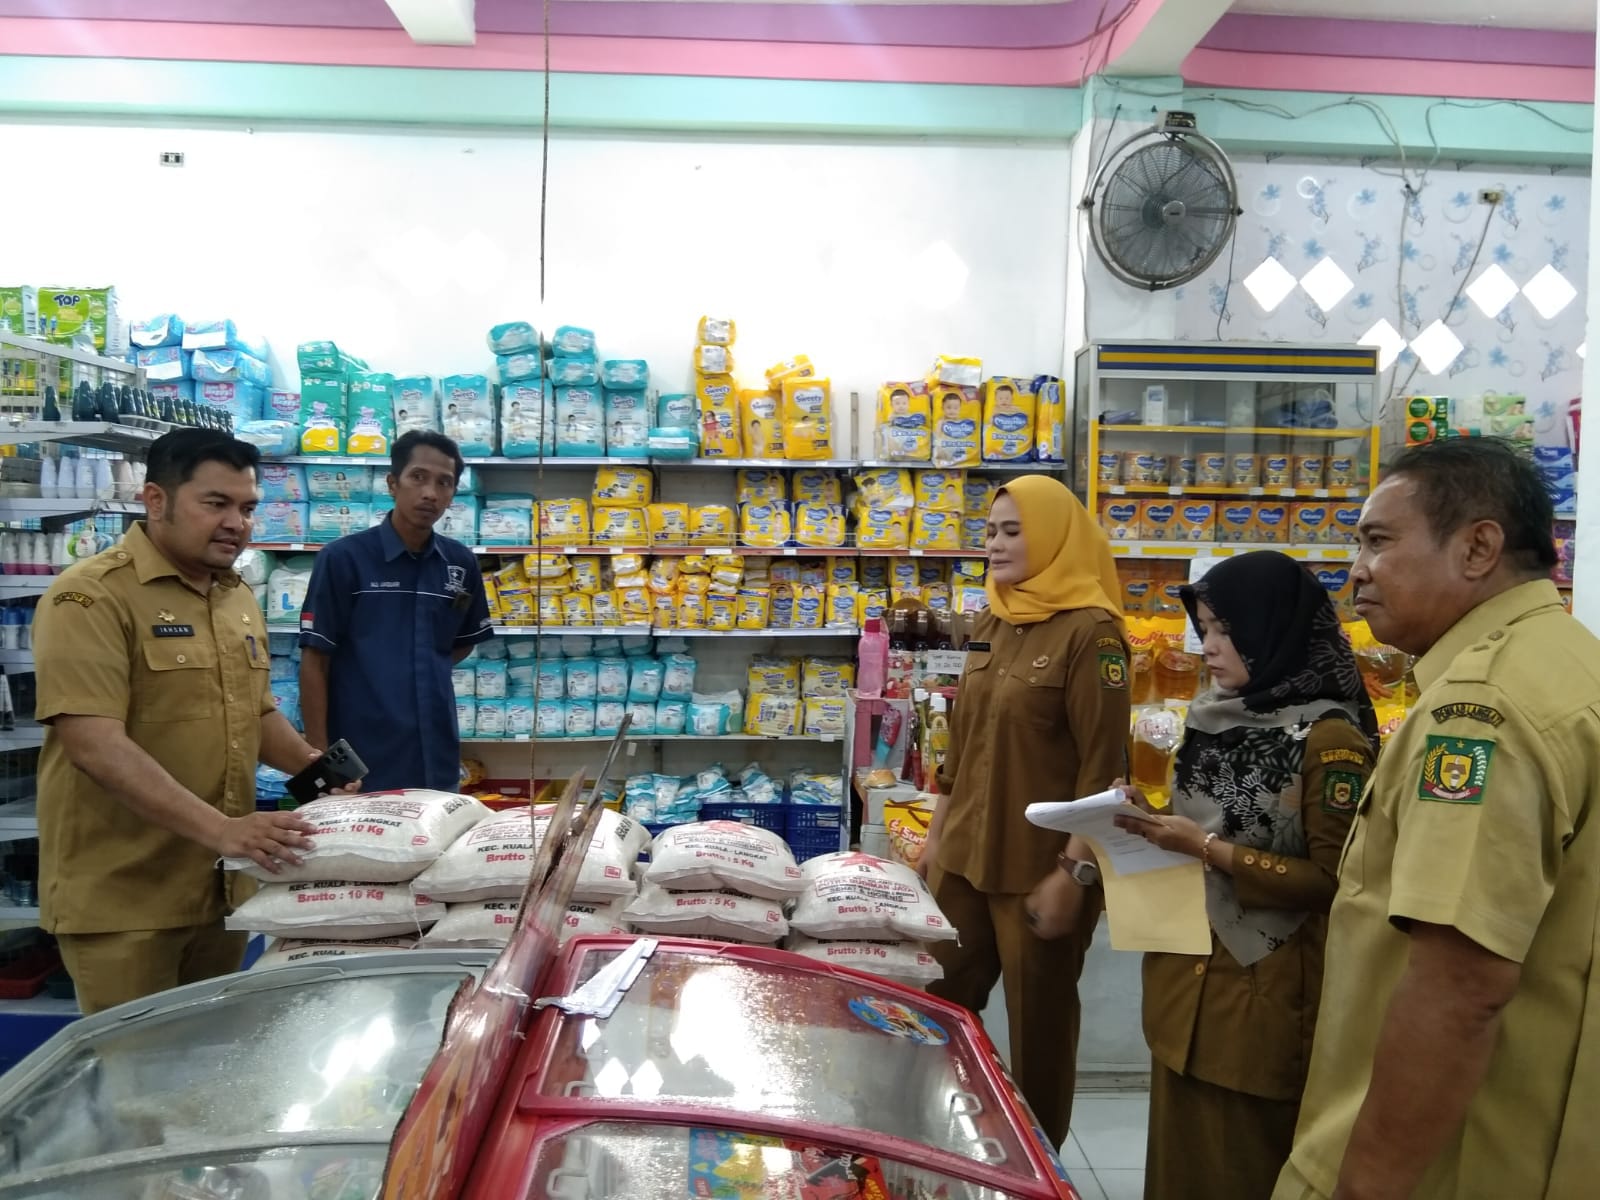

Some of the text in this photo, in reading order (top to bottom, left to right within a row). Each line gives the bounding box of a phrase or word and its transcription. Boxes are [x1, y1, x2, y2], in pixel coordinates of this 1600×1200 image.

[53, 294, 80, 306] TOP
[795, 393, 823, 403] Sweety
[282, 592, 295, 611] L
[358, 817, 402, 828] LANGKAT
[351, 824, 365, 832] 10
[368, 824, 385, 836] Kg
[477, 845, 499, 853] KEC.
[486, 853, 525, 863] Brutto
[695, 851, 725, 861] Brutto
[741, 858, 755, 868] Kg
[297, 893, 336, 903] Brutto
[348, 891, 362, 899] 10
[367, 889, 384, 900] Kg
[677, 898, 706, 906] Brutto
[714, 898, 721, 906] 5
[723, 899, 736, 908] Kg
[879, 902, 908, 911] ANGKAT
[288, 953, 310, 961] KEC.
[827, 947, 857, 956] Brutto
[874, 948, 887, 958] Kg
